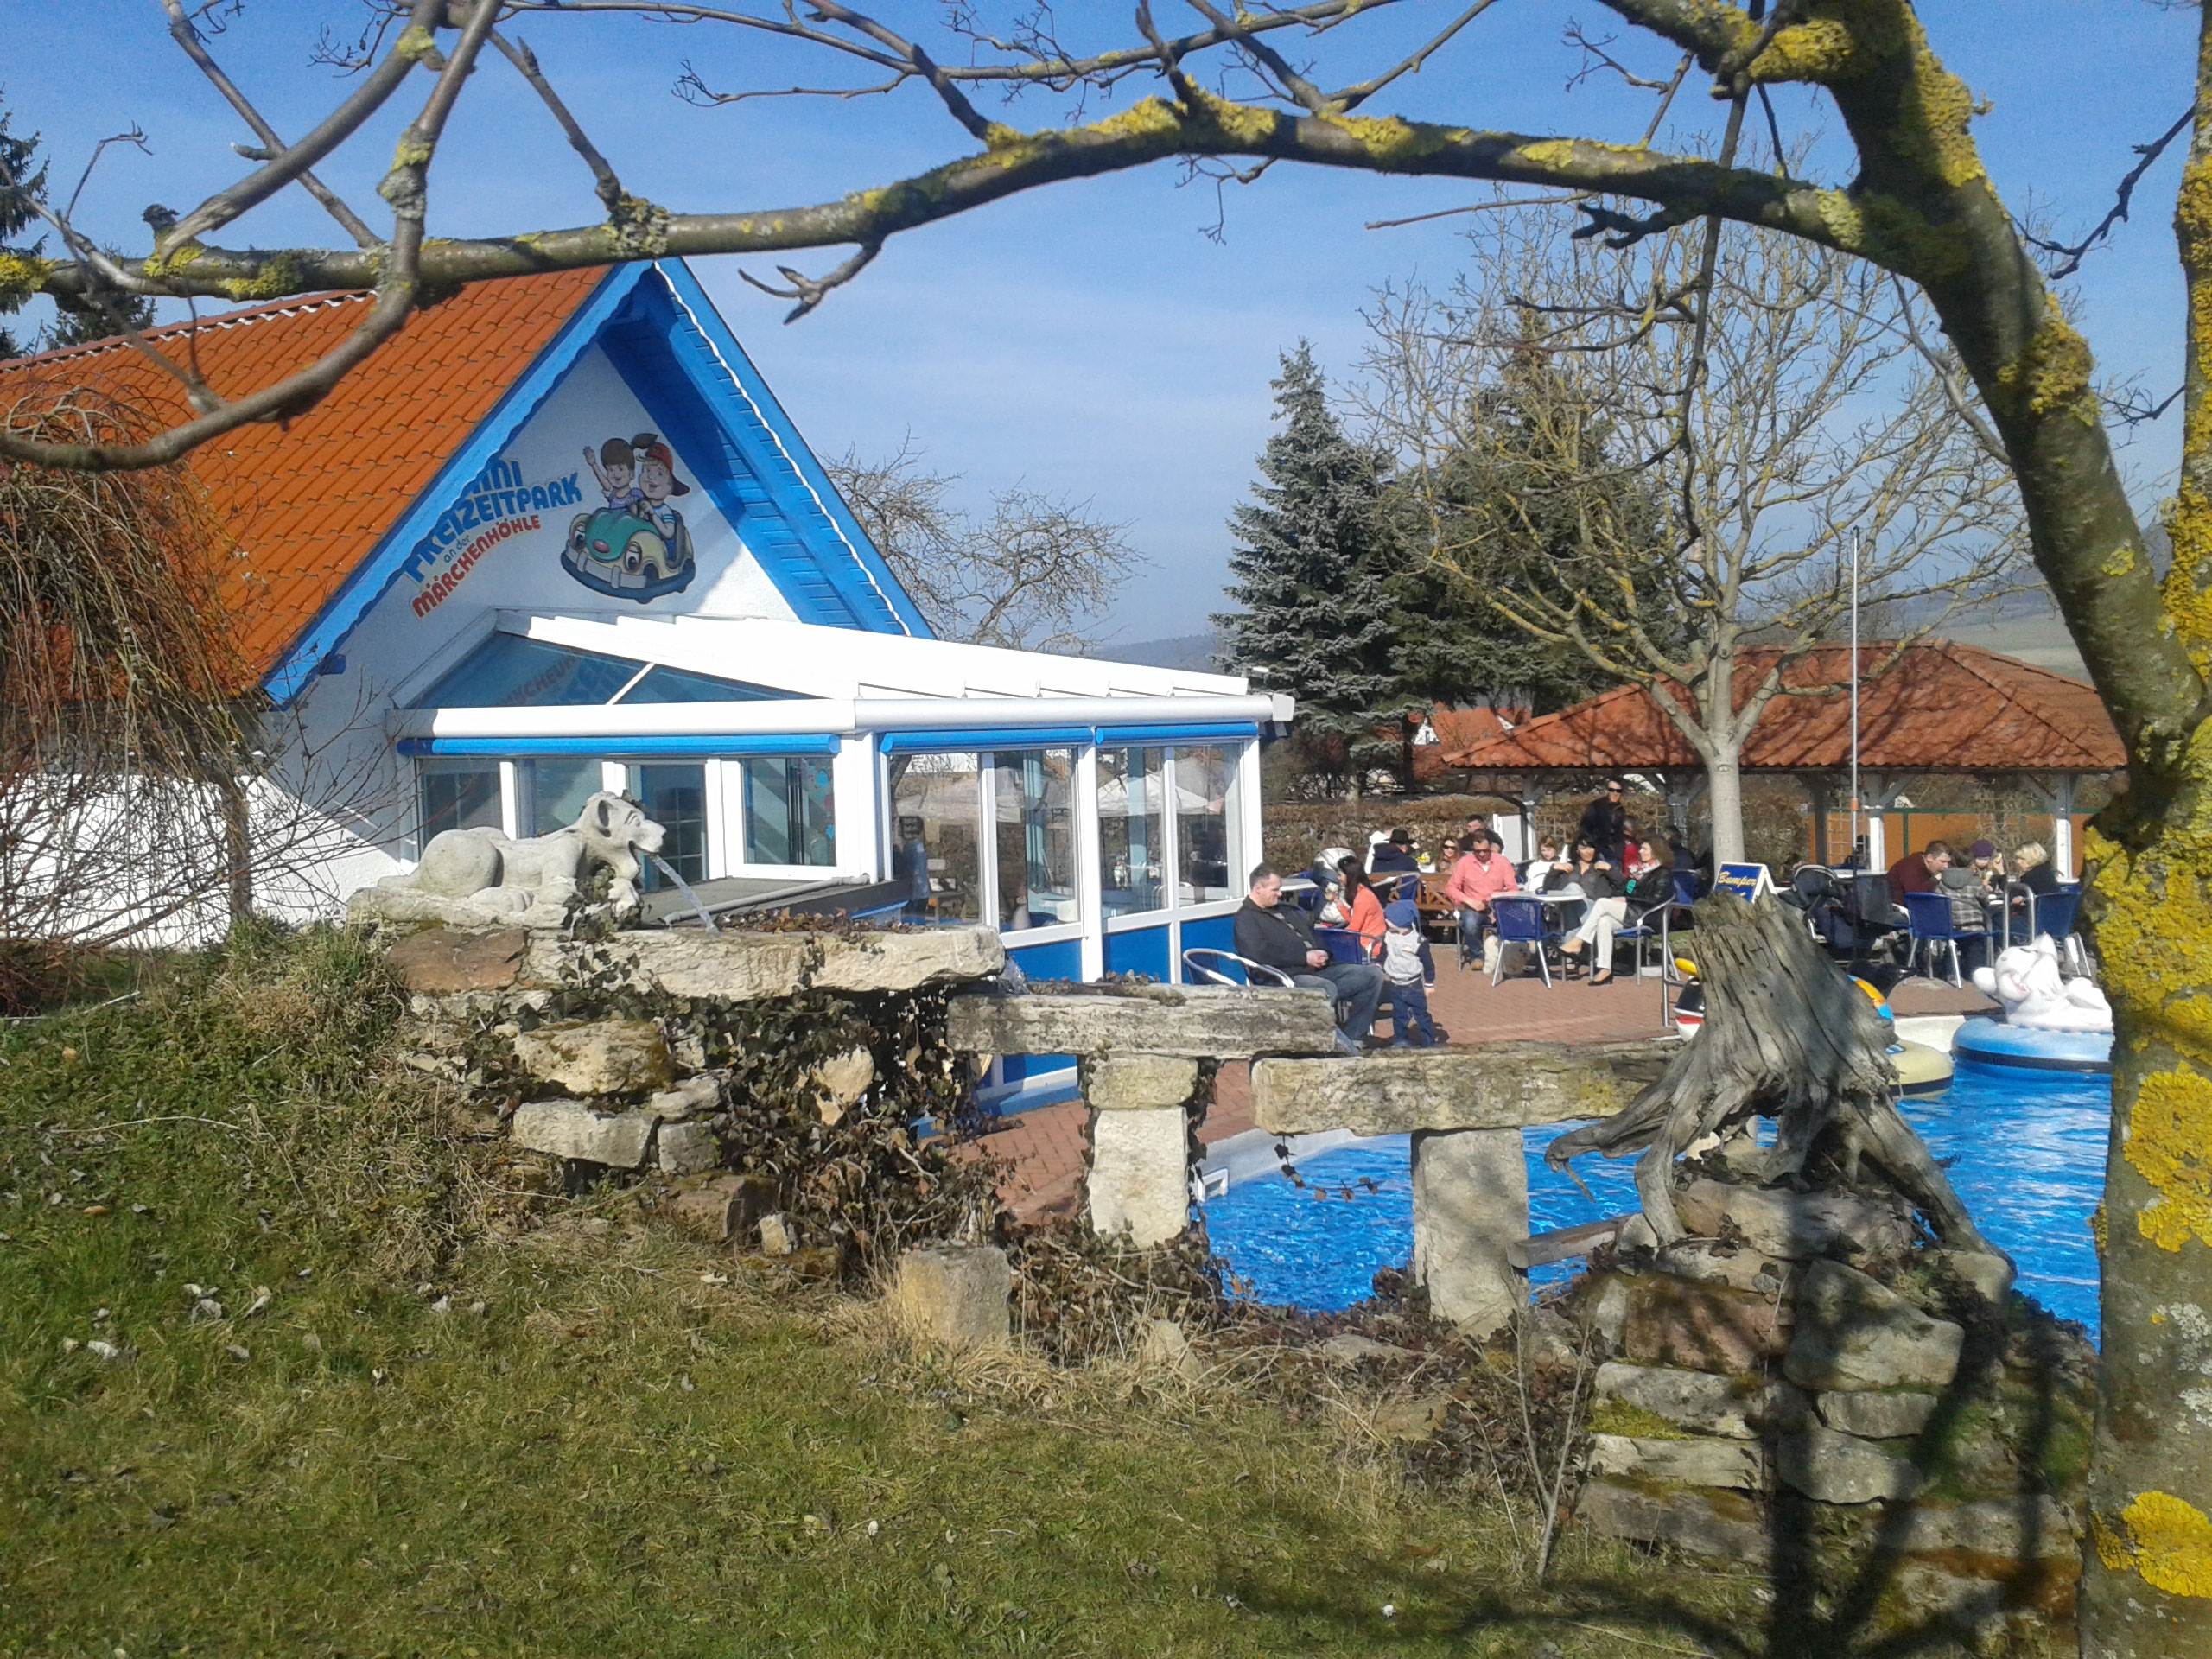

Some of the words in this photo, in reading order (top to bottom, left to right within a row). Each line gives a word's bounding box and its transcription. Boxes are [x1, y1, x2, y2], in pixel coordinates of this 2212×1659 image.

[412, 514, 541, 618] MÄRCHENHÖHLE
[443, 549, 457, 563] an
[456, 535, 471, 550] der
